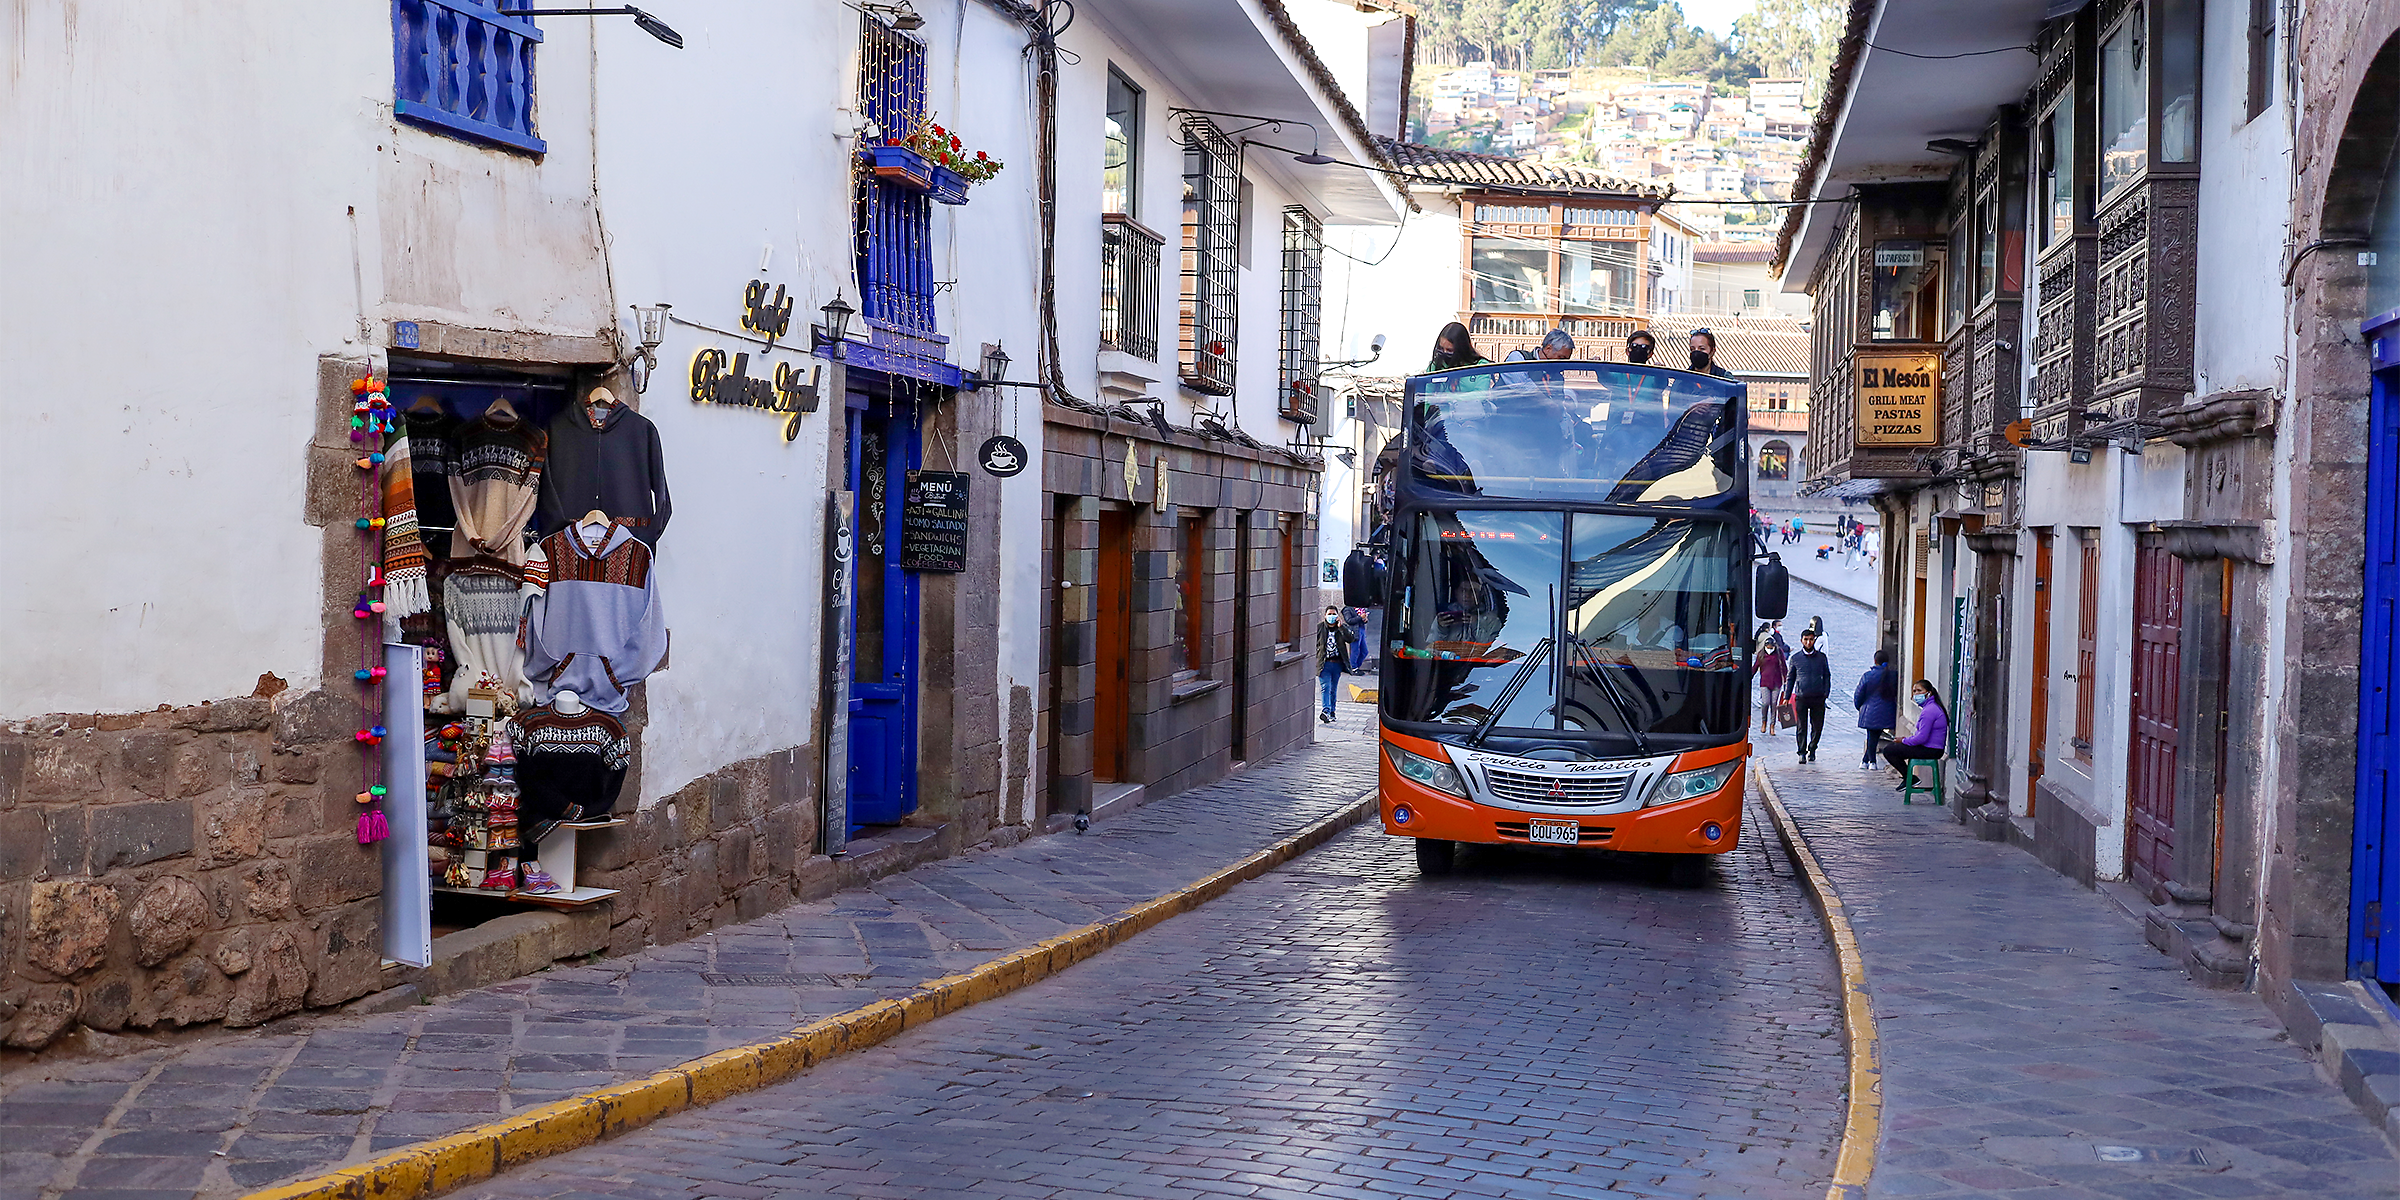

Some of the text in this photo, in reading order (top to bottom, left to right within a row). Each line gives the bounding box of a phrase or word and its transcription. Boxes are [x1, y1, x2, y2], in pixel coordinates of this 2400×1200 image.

[1862, 365, 1931, 388] El Mesón
[1868, 395, 1927, 406] GRILL MEAT
[1874, 409, 1922, 419] PASTAS
[1873, 424, 1922, 435] PIZZAS
[931, 519, 967, 531] SALTADO
[918, 553, 944, 561] FOOD
[1467, 752, 1548, 771] Servicio
[1531, 825, 1576, 841] COU-965
